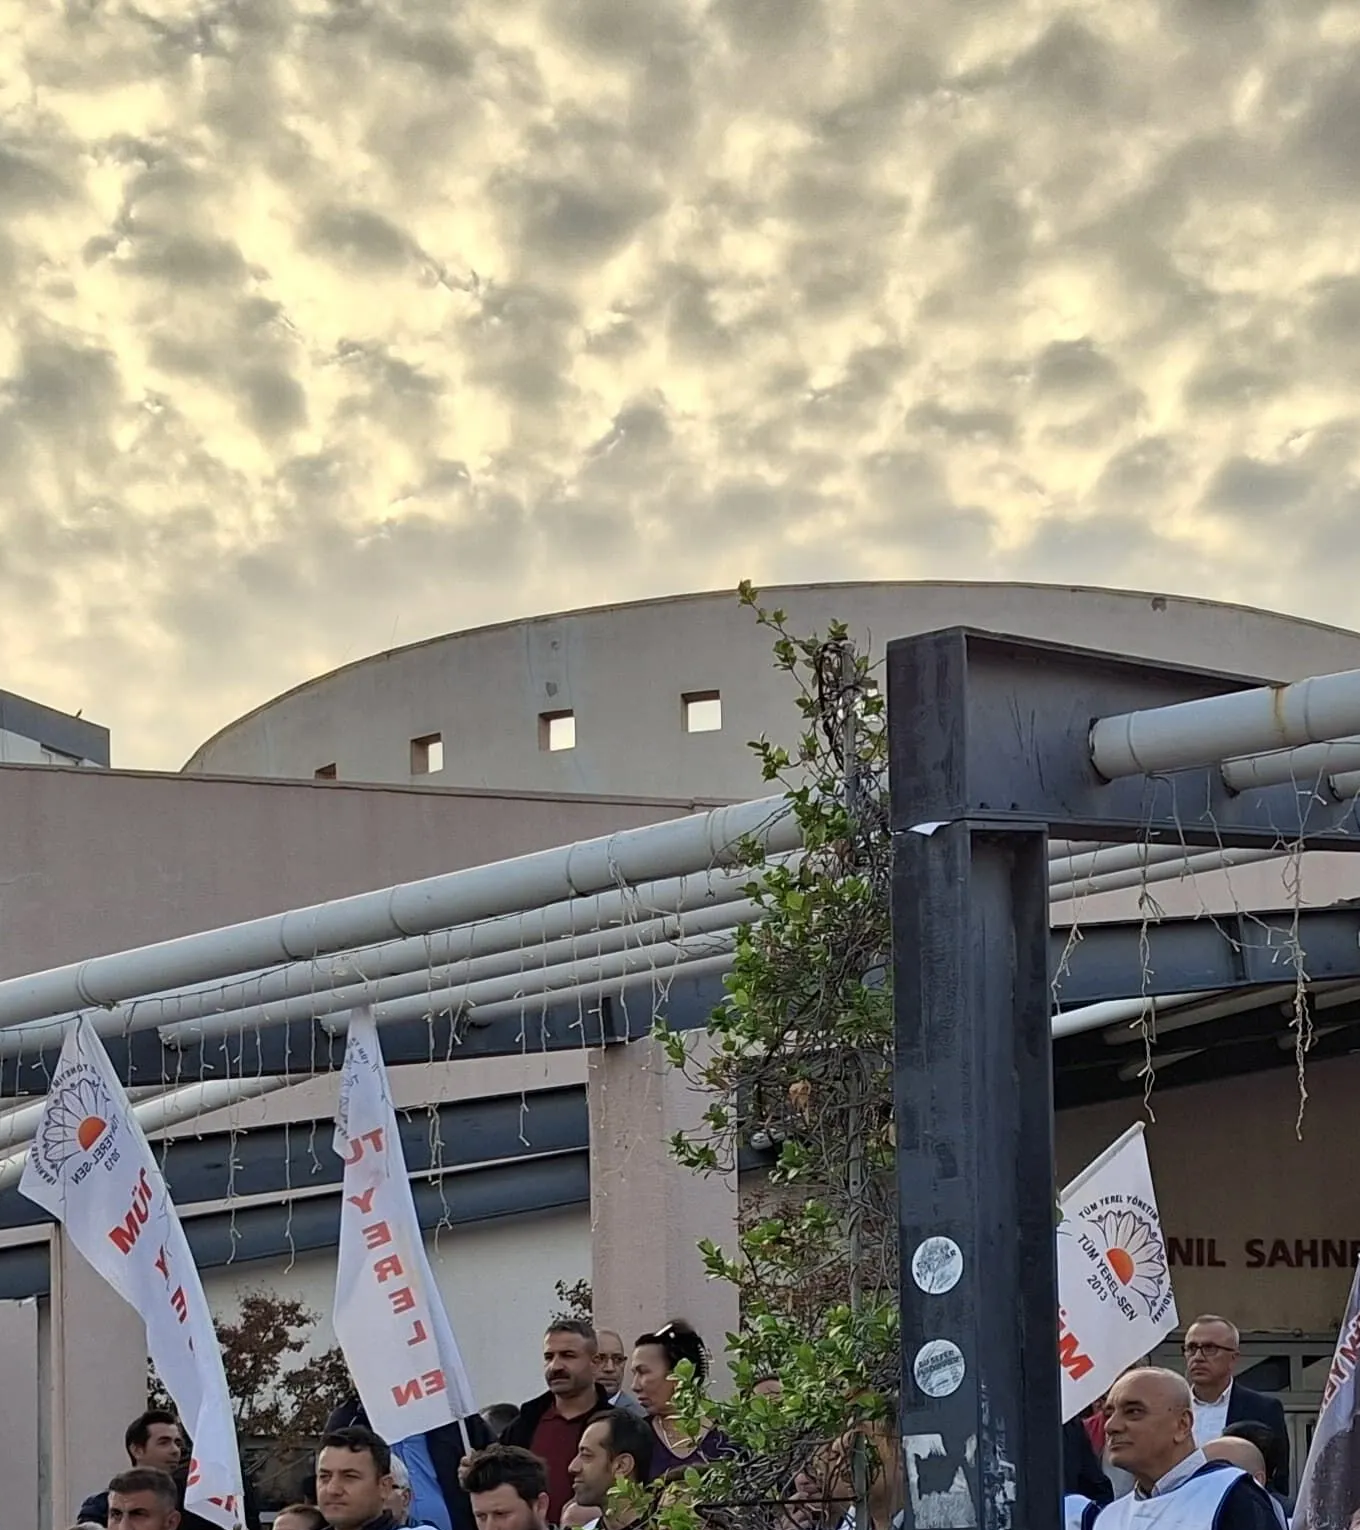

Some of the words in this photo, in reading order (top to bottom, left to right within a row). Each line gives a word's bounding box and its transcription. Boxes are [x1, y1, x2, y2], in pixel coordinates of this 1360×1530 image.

[1167, 1237, 1226, 1267] NIL
[1077, 1233, 1098, 1262] TÜM
[1097, 1258, 1139, 1323] YEREL-SEN
[1086, 1275, 1109, 1303] 2013
